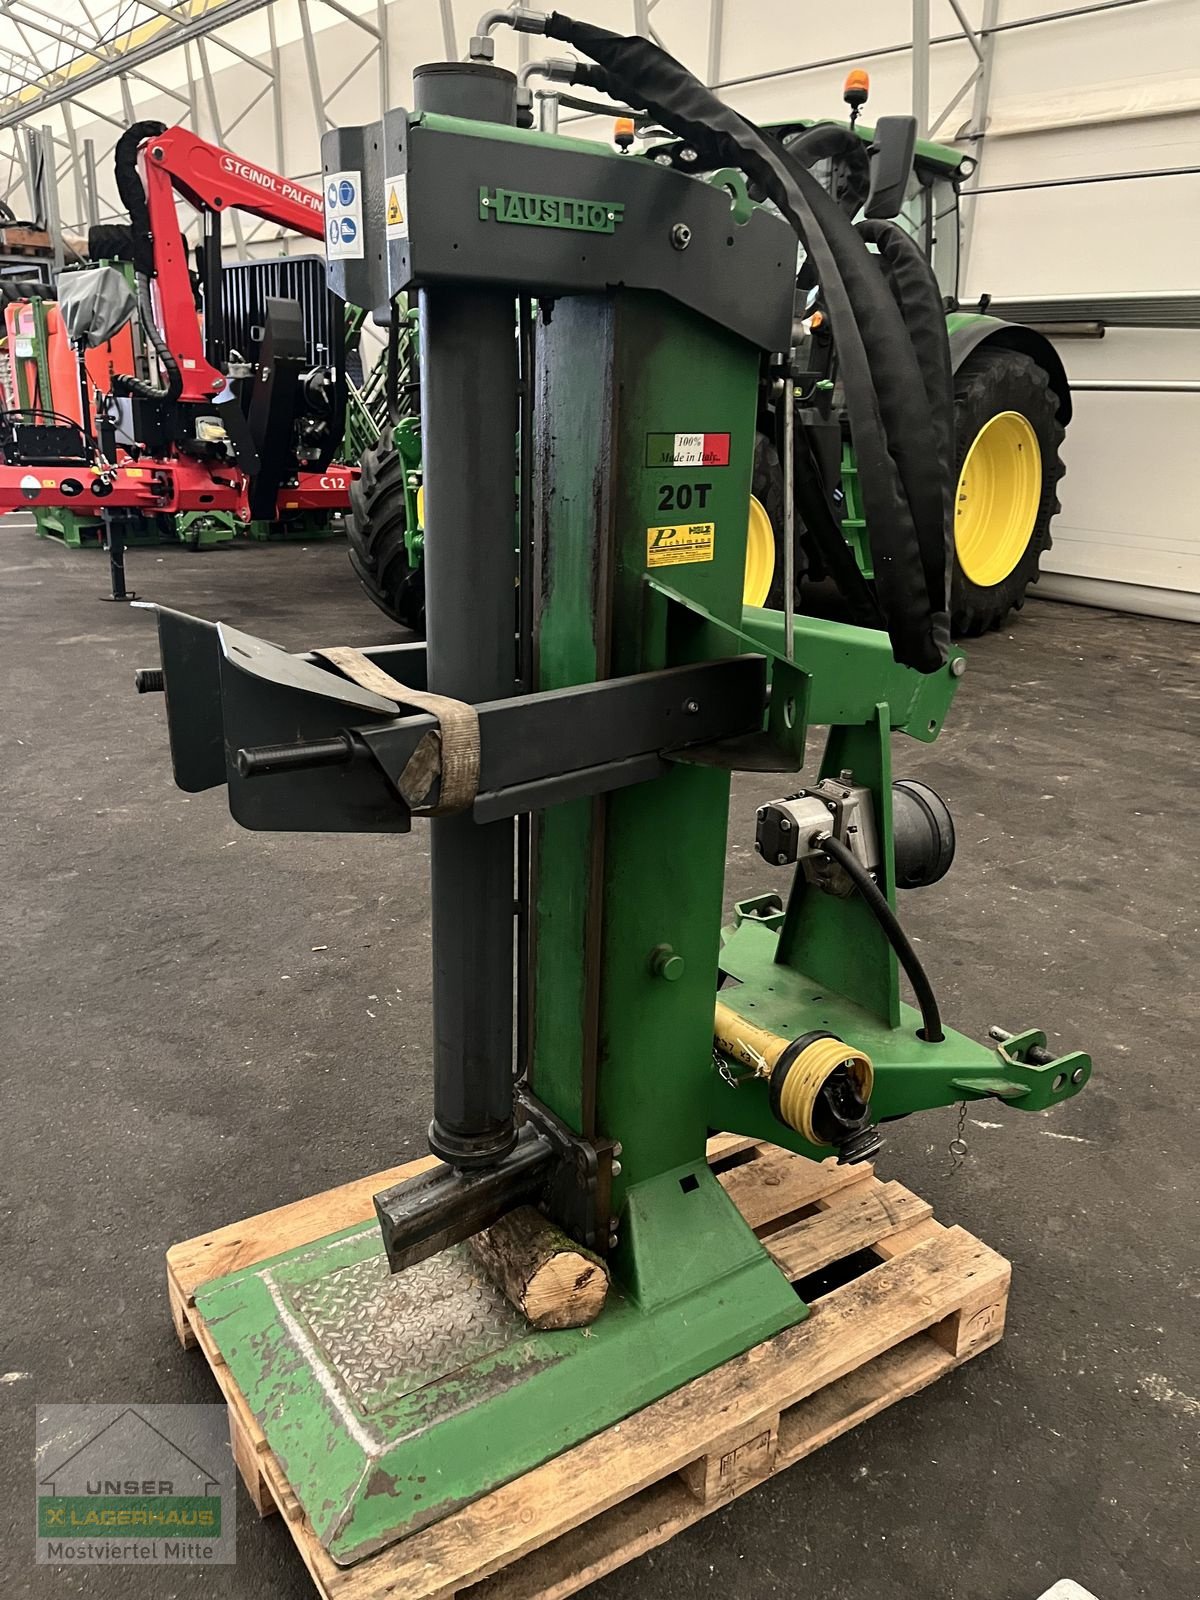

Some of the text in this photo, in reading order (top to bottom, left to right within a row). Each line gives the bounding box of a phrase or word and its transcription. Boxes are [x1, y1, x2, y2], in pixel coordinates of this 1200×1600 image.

[479, 186, 625, 233] HAUSLHOF
[678, 437, 701, 447] 100%
[661, 452, 684, 463] Made
[686, 452, 695, 462] in
[320, 477, 346, 489] C12
[658, 484, 712, 511] 20T
